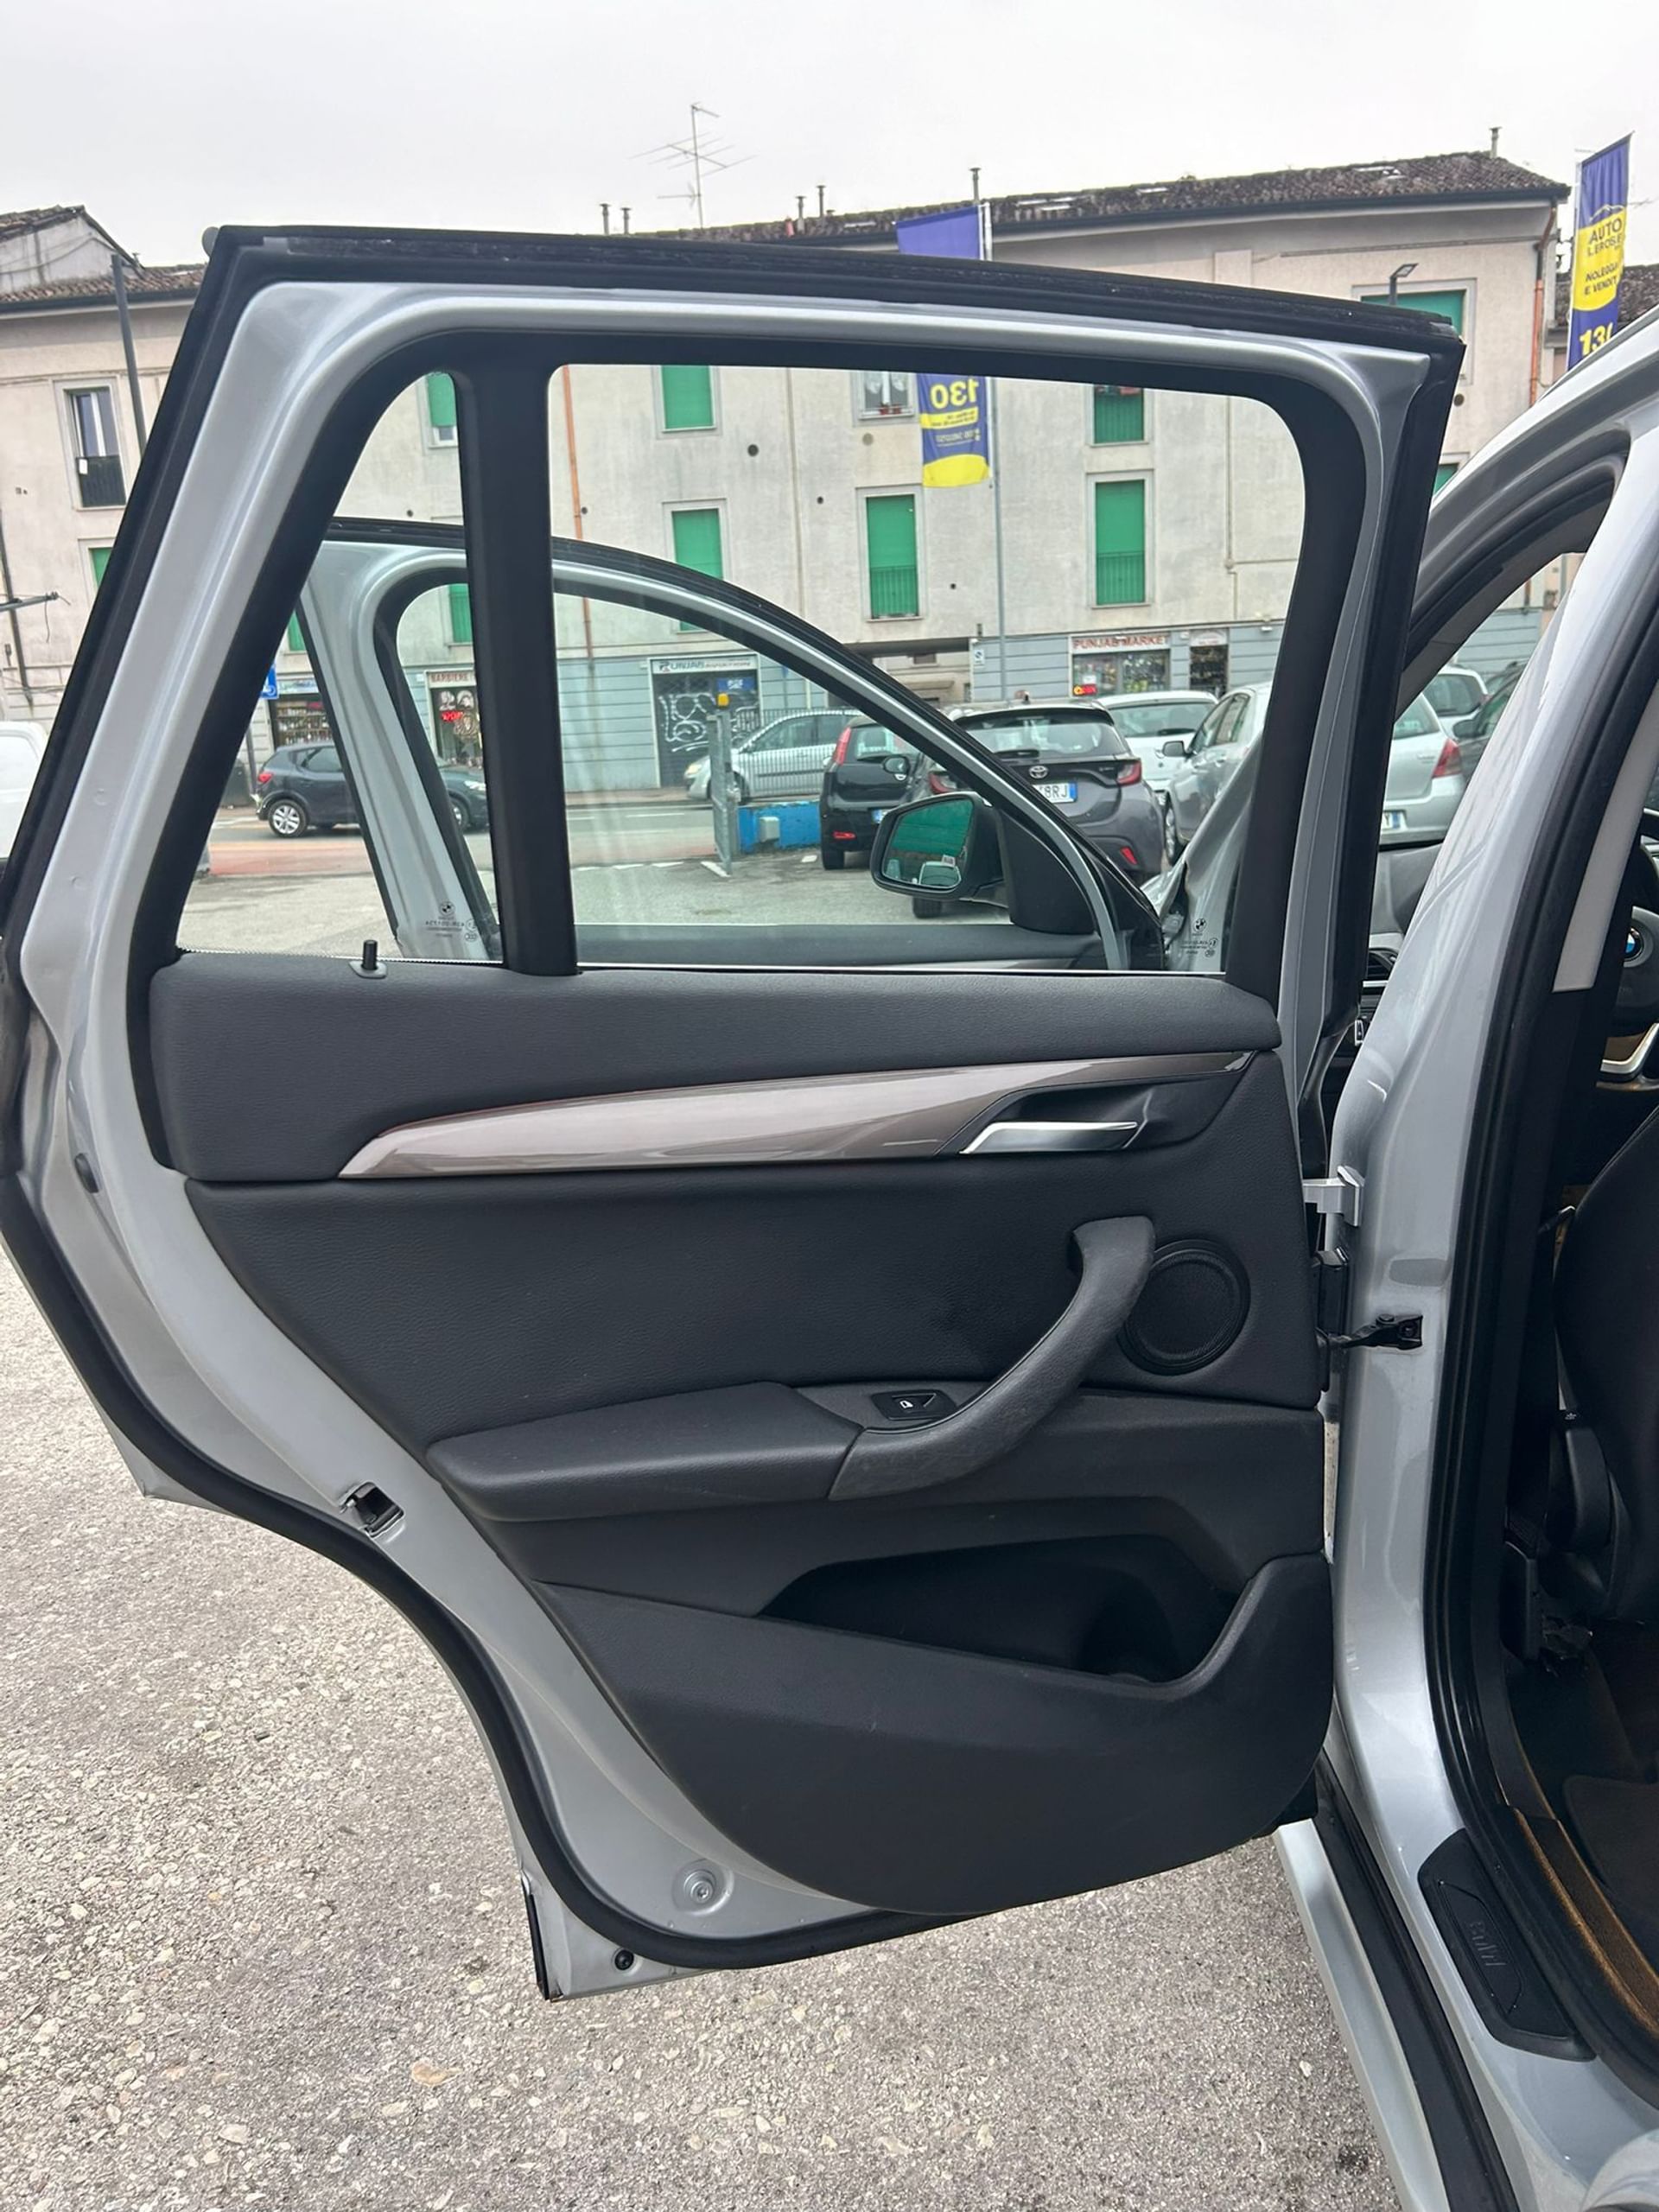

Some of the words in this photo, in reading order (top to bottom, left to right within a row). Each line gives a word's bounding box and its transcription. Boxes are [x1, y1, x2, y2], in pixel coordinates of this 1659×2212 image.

[1589, 218, 1622, 245] AUTO
[1584, 285, 1591, 296] E
[1073, 637, 1121, 650] PUNJAB
[1124, 634, 1169, 647] MARKET
